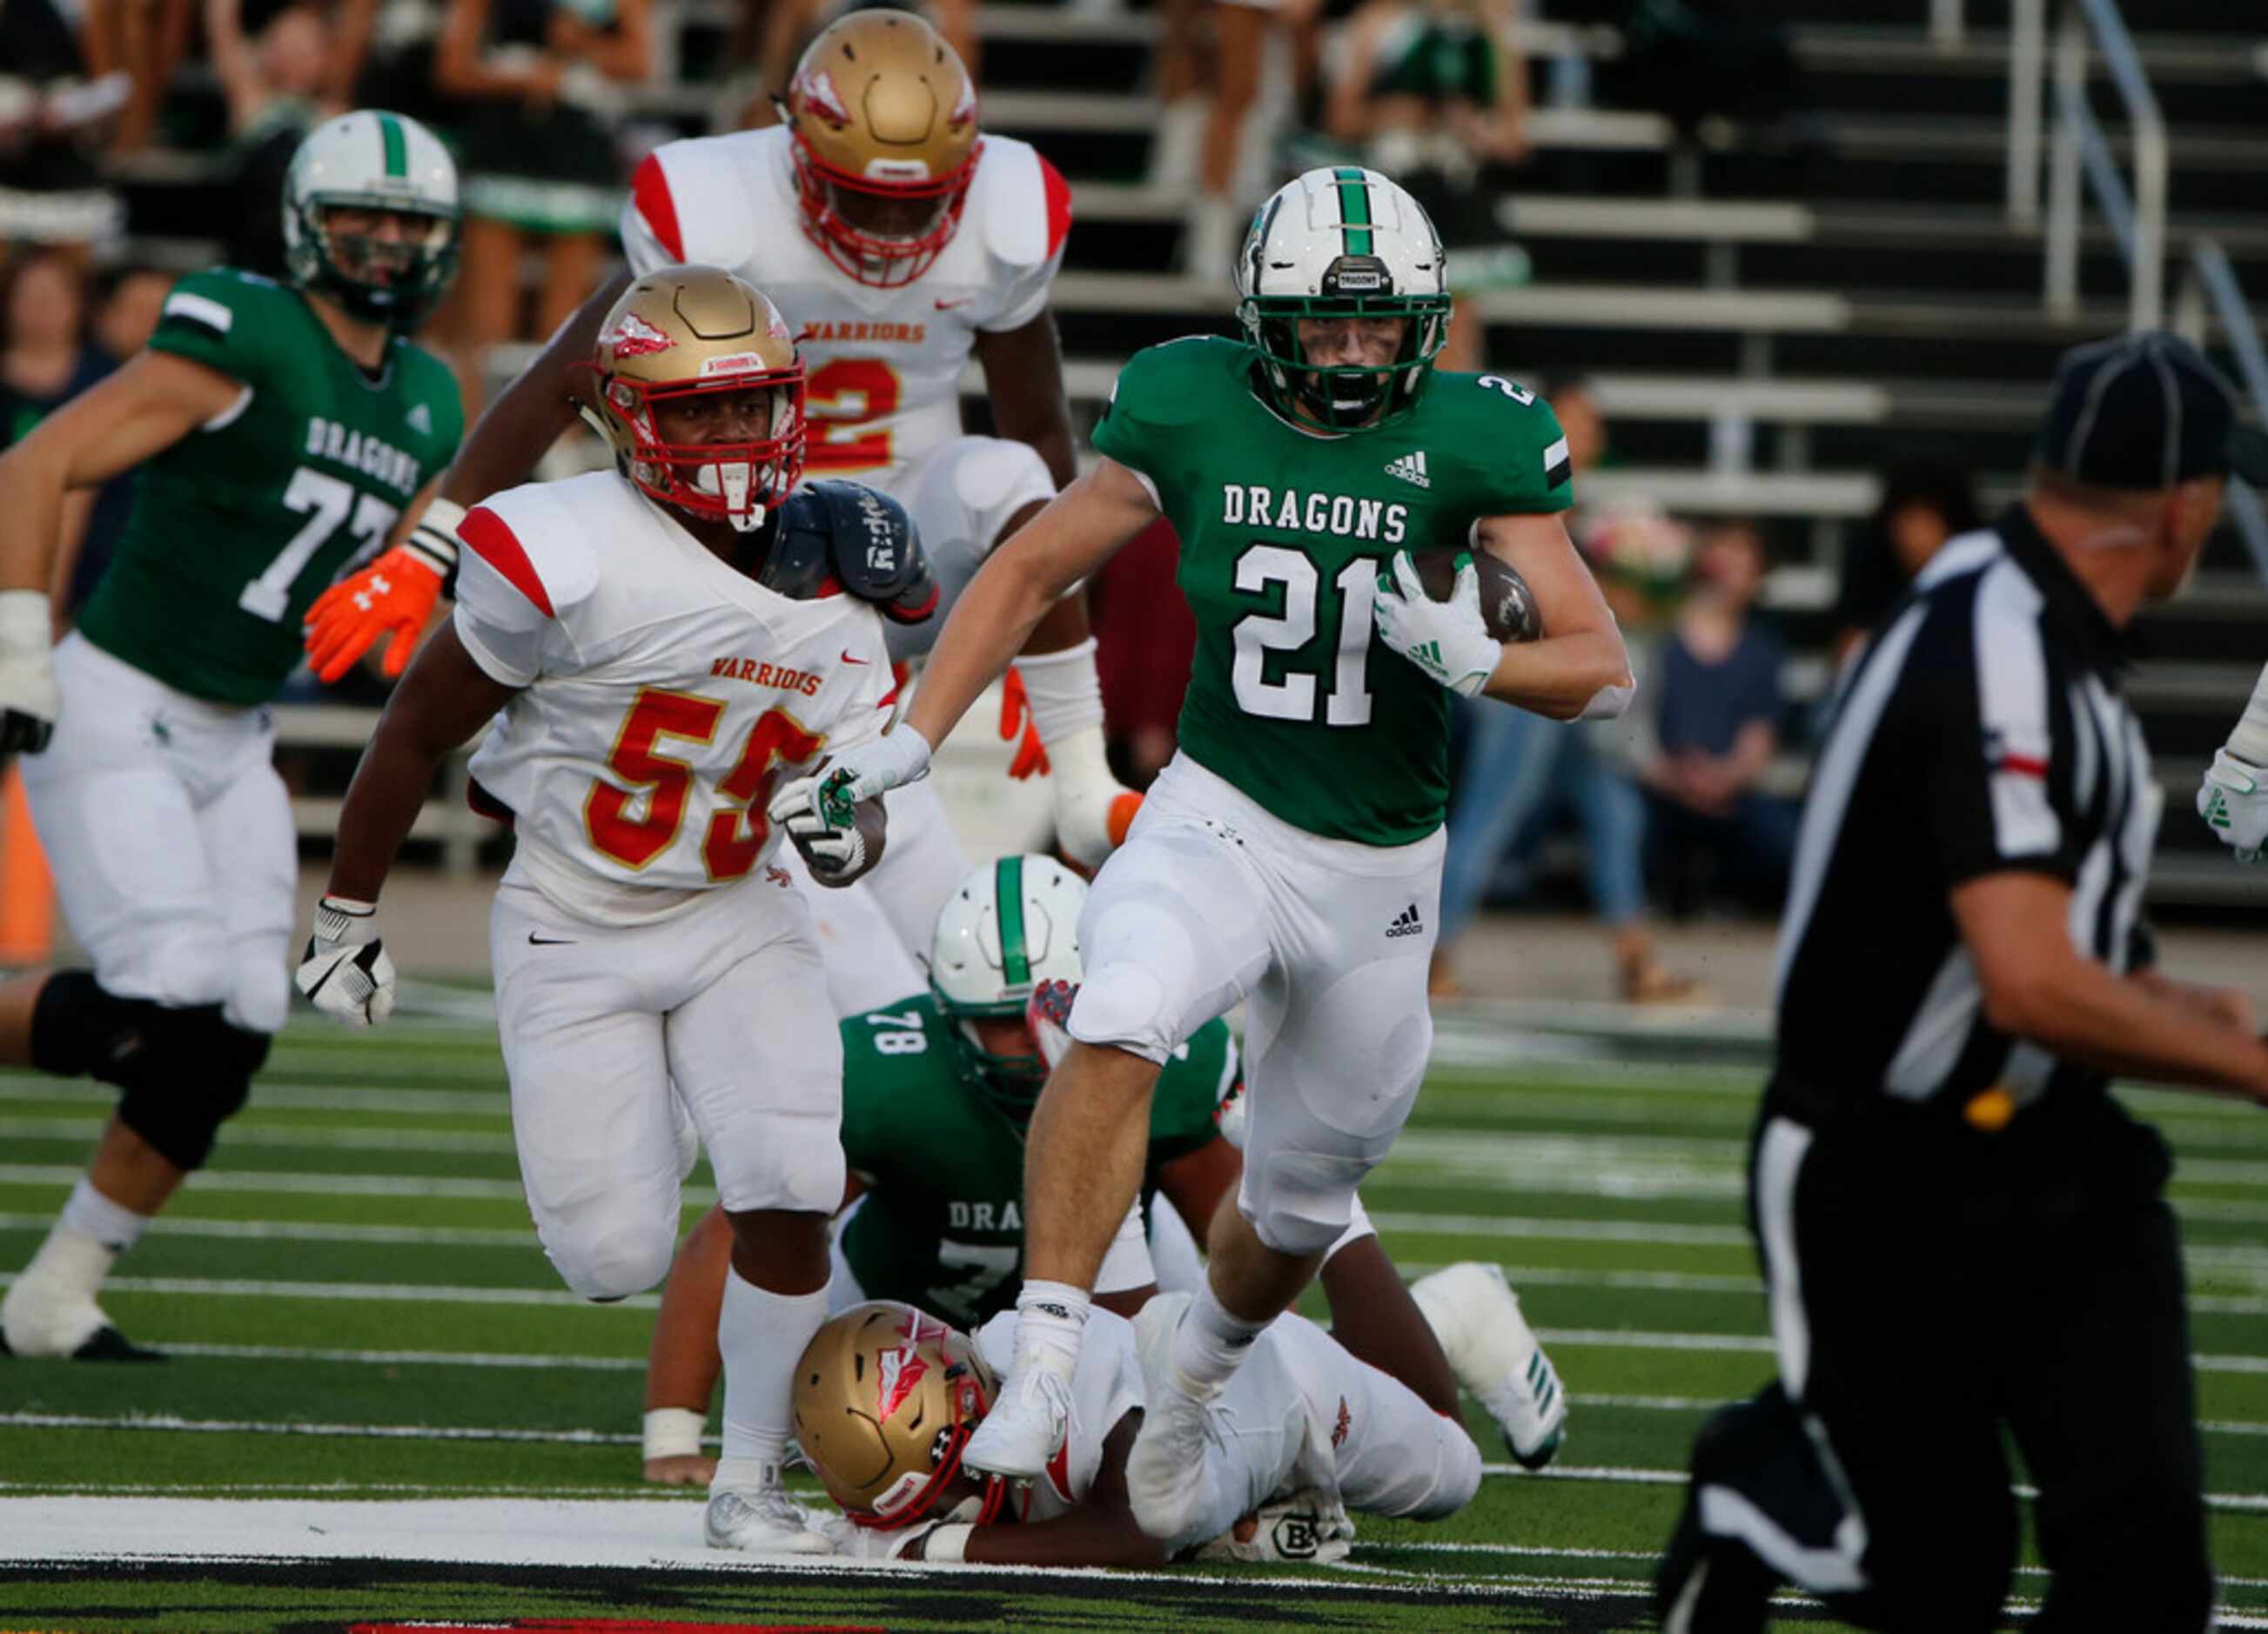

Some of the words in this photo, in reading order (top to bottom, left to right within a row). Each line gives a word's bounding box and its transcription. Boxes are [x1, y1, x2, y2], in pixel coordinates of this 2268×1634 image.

[803, 321, 925, 344] WARRIORS
[306, 417, 420, 496] DRAGONS
[1223, 484, 1408, 544] DRAGONS
[1231, 543, 1379, 727] 21
[866, 1010, 928, 1055] 78
[949, 1200, 1023, 1231] DRA
